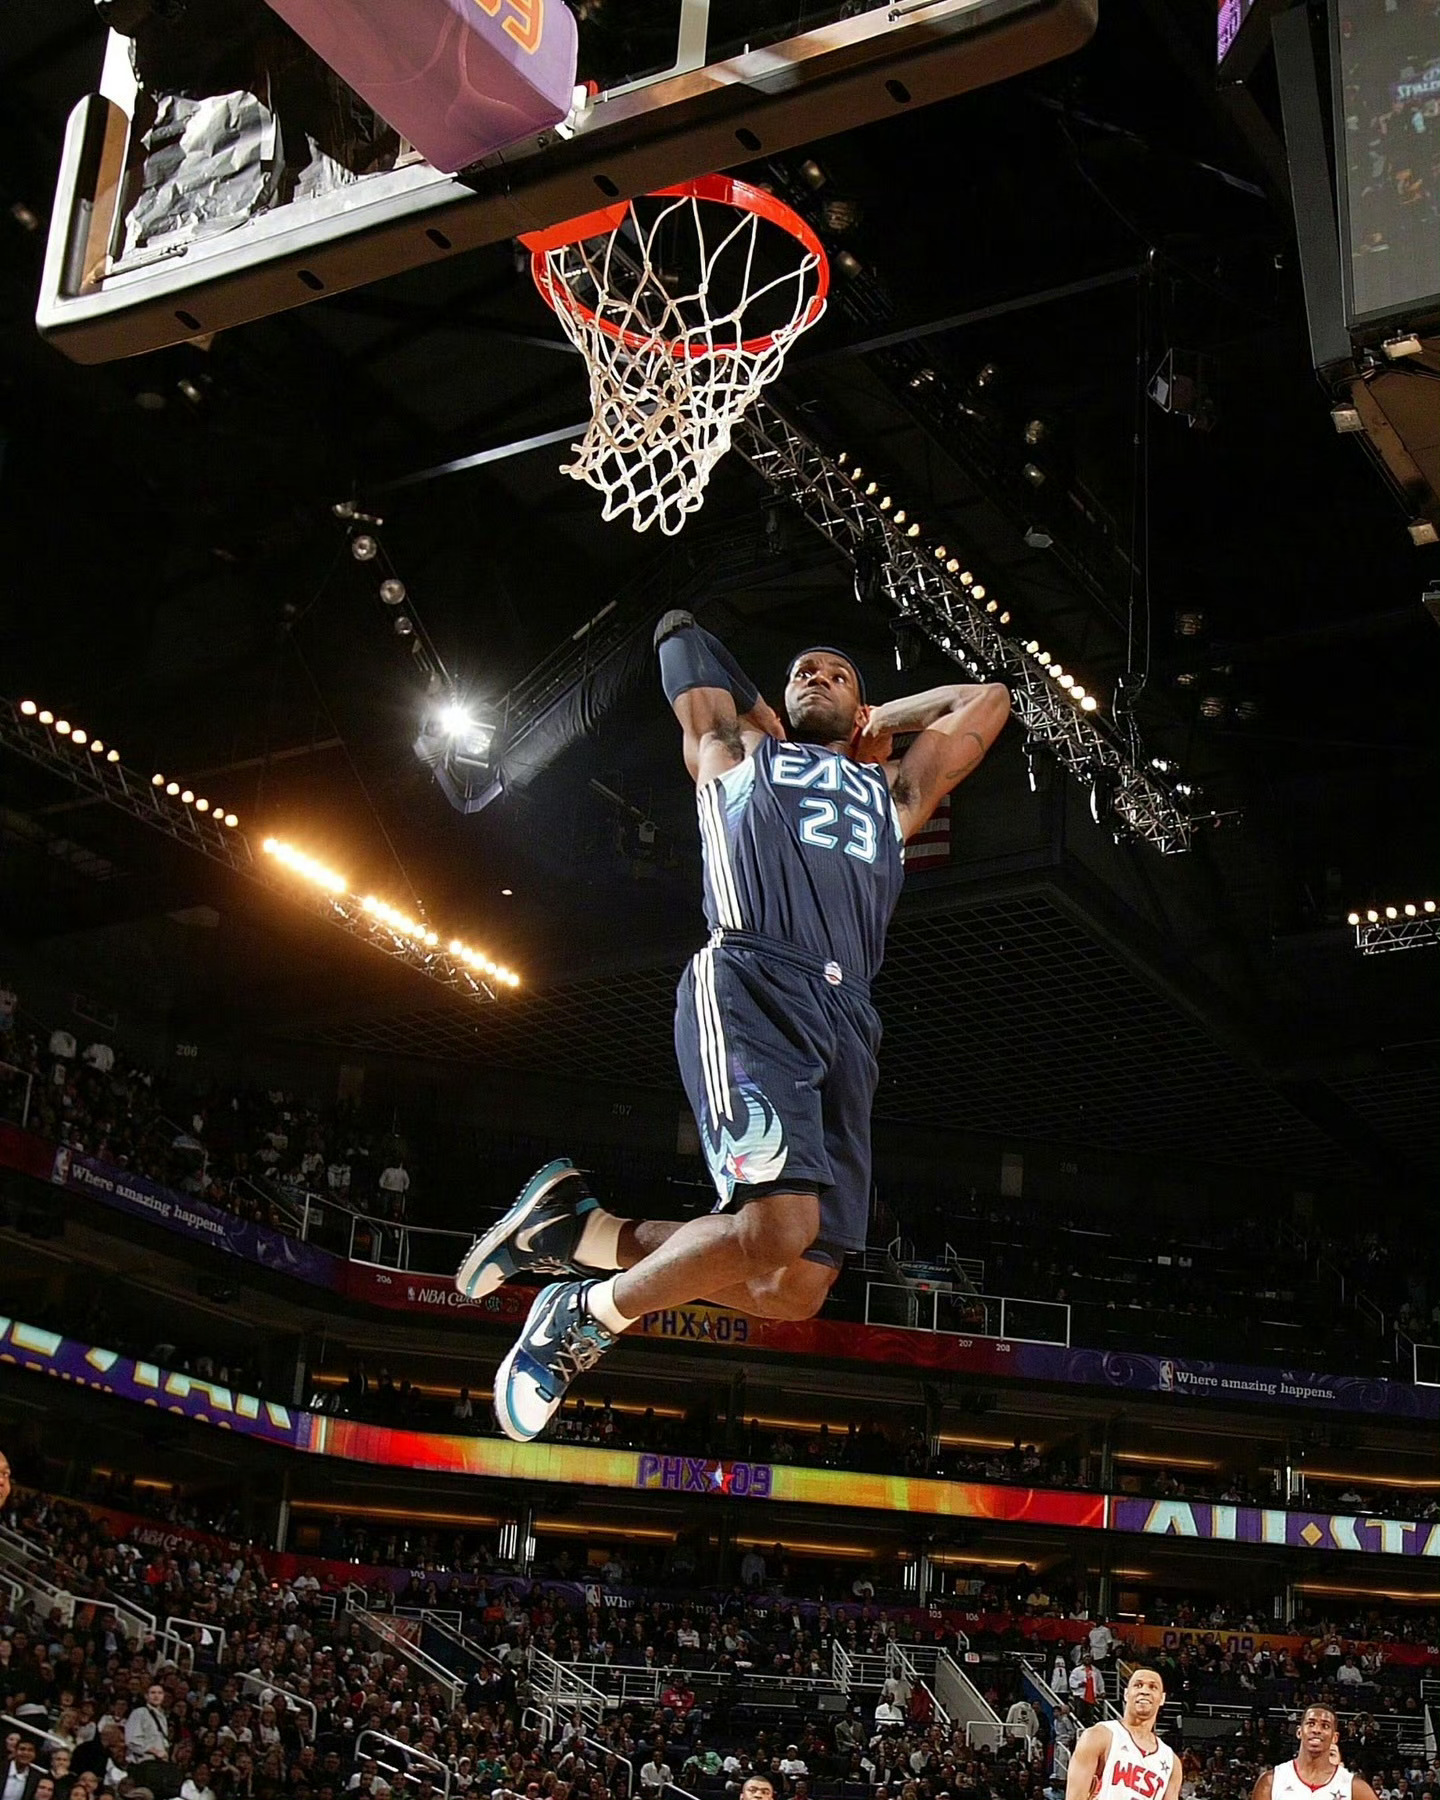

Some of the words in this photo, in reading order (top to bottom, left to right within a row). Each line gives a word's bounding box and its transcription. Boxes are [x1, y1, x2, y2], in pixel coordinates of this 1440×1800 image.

[769, 753, 888, 820] EAST
[799, 797, 877, 864] 23
[71, 1163, 114, 1191] Where
[115, 1183, 172, 1218] amazing
[173, 1204, 227, 1237] happens.
[375, 1274, 392, 1284] 206
[418, 1288, 446, 1305] NBA
[643, 1309, 697, 1337] PHX
[717, 1316, 748, 1341] 09
[958, 1338, 973, 1348] 207
[1175, 1371, 1218, 1386] Where
[1221, 1379, 1277, 1395] amazing
[1280, 1382, 1336, 1399] happens.
[637, 1453, 706, 1492] PHX
[731, 1461, 773, 1498] 09
[965, 1612, 980, 1621] 106
[1111, 1760, 1165, 1800] WEST
